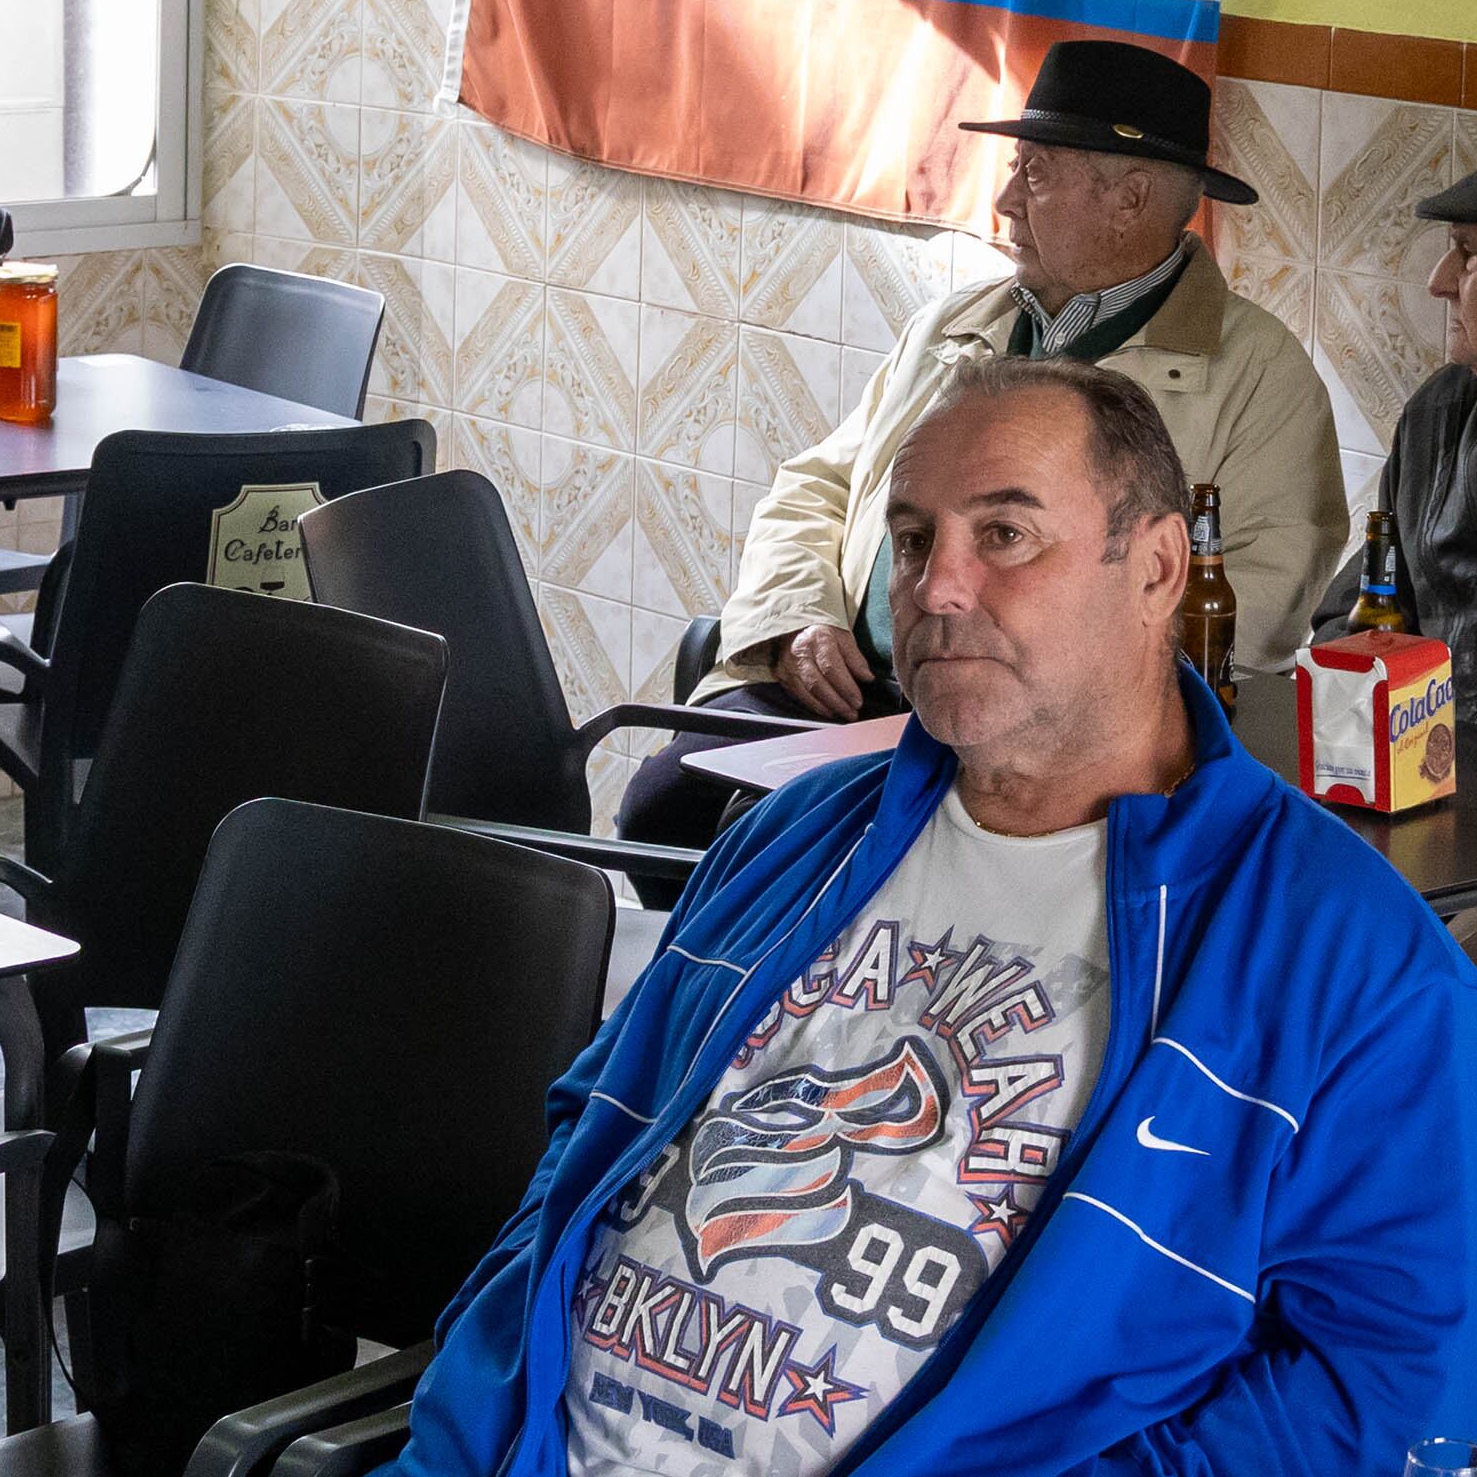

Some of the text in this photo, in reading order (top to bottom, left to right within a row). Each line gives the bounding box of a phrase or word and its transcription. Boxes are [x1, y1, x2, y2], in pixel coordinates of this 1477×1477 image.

[258, 504, 299, 534] Bar
[918, 934, 1071, 1184] WEAR
[584, 1256, 803, 1420] BKLYN
[830, 1222, 962, 1344] 99
